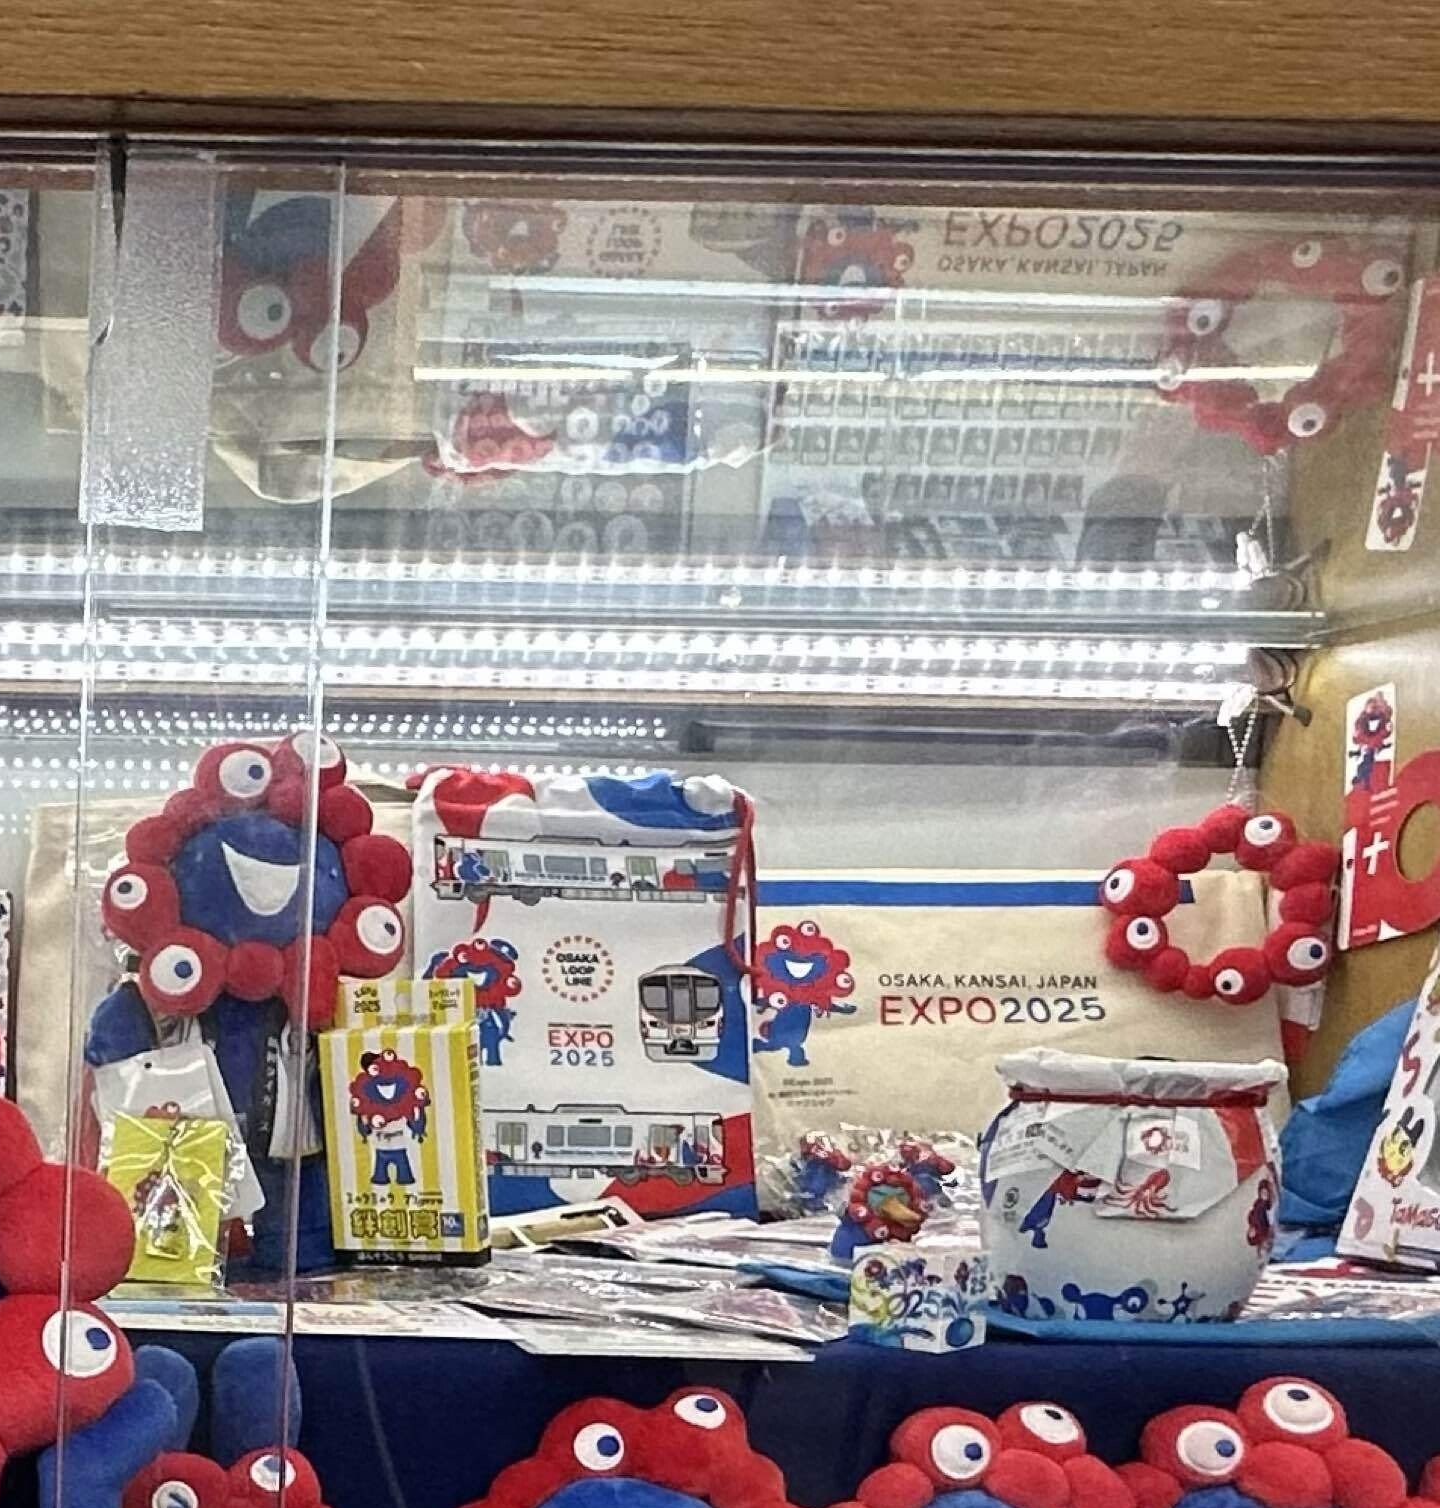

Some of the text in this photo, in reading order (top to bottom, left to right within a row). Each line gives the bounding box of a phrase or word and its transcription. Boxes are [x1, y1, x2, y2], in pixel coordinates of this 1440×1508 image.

[555, 952, 600, 964] OSAKA
[560, 964, 595, 976] LOOP
[564, 975, 593, 987] LINE
[877, 972, 1098, 990] OSAKA, KANSAI, JAPAN
[878, 994, 1108, 1027] EXPO2025
[547, 1028, 614, 1049] EXPO
[549, 1049, 616, 1068] 2025
